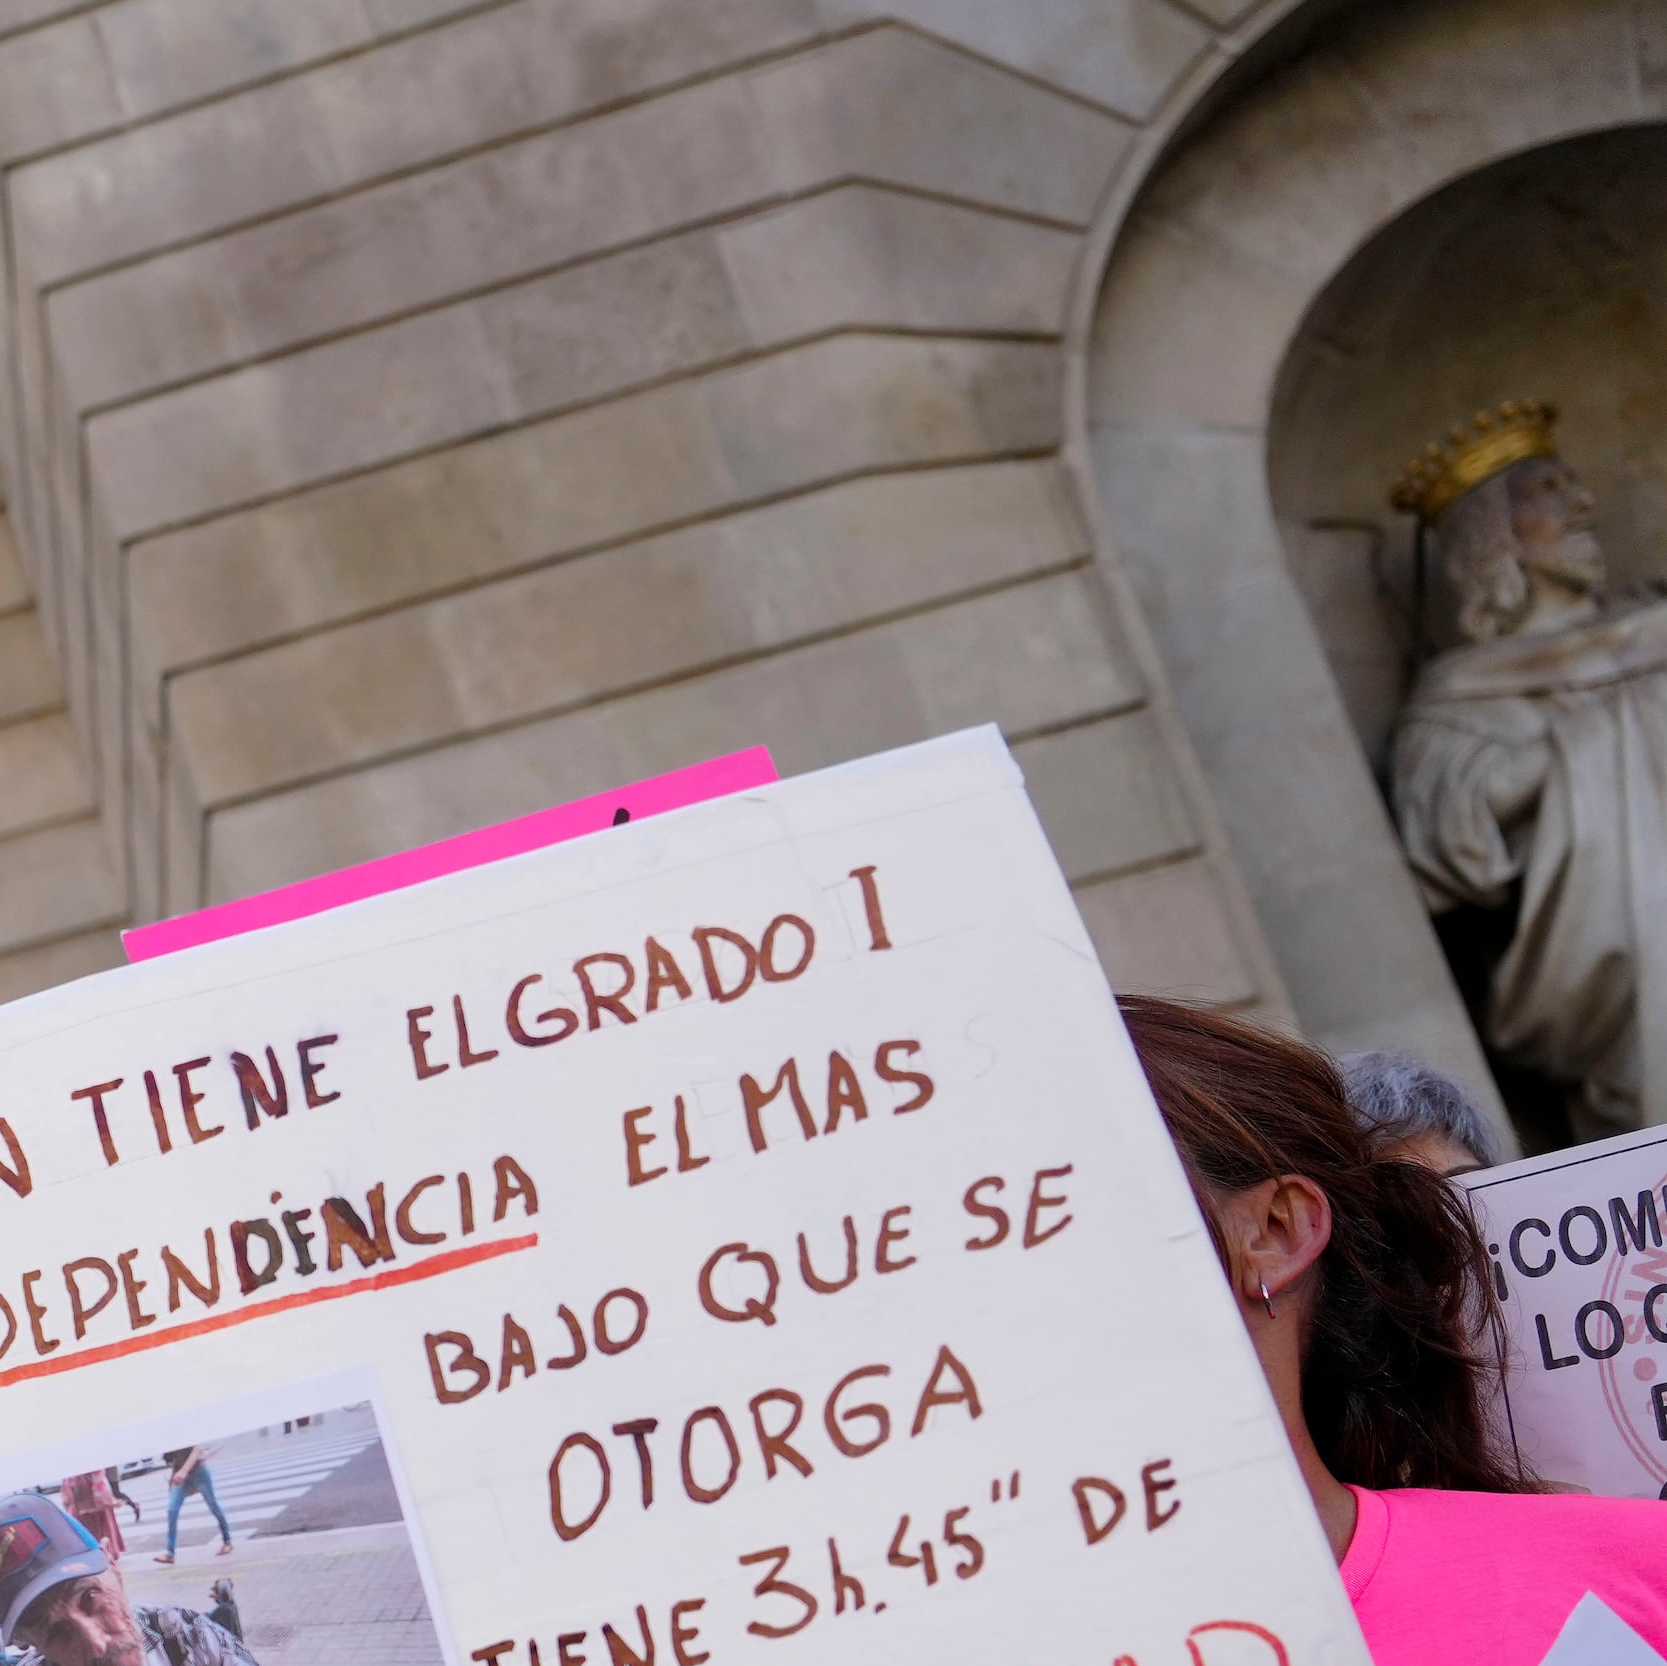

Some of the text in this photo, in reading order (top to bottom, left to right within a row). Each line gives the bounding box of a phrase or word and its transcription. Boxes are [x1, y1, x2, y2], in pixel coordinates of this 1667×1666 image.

[70, 1033, 341, 1168] TIENE
[849, 864, 892, 952] I
[622, 1095, 710, 1187] EL
[740, 1039, 935, 1154] MAS
[424, 1163, 1074, 1405] BAJO QUE SE
[1489, 1186, 1667, 1302] ¡COM
[1534, 1299, 1626, 1371] LO
[547, 1344, 984, 1542] OTORGA
[1070, 1458, 1182, 1545] DE
